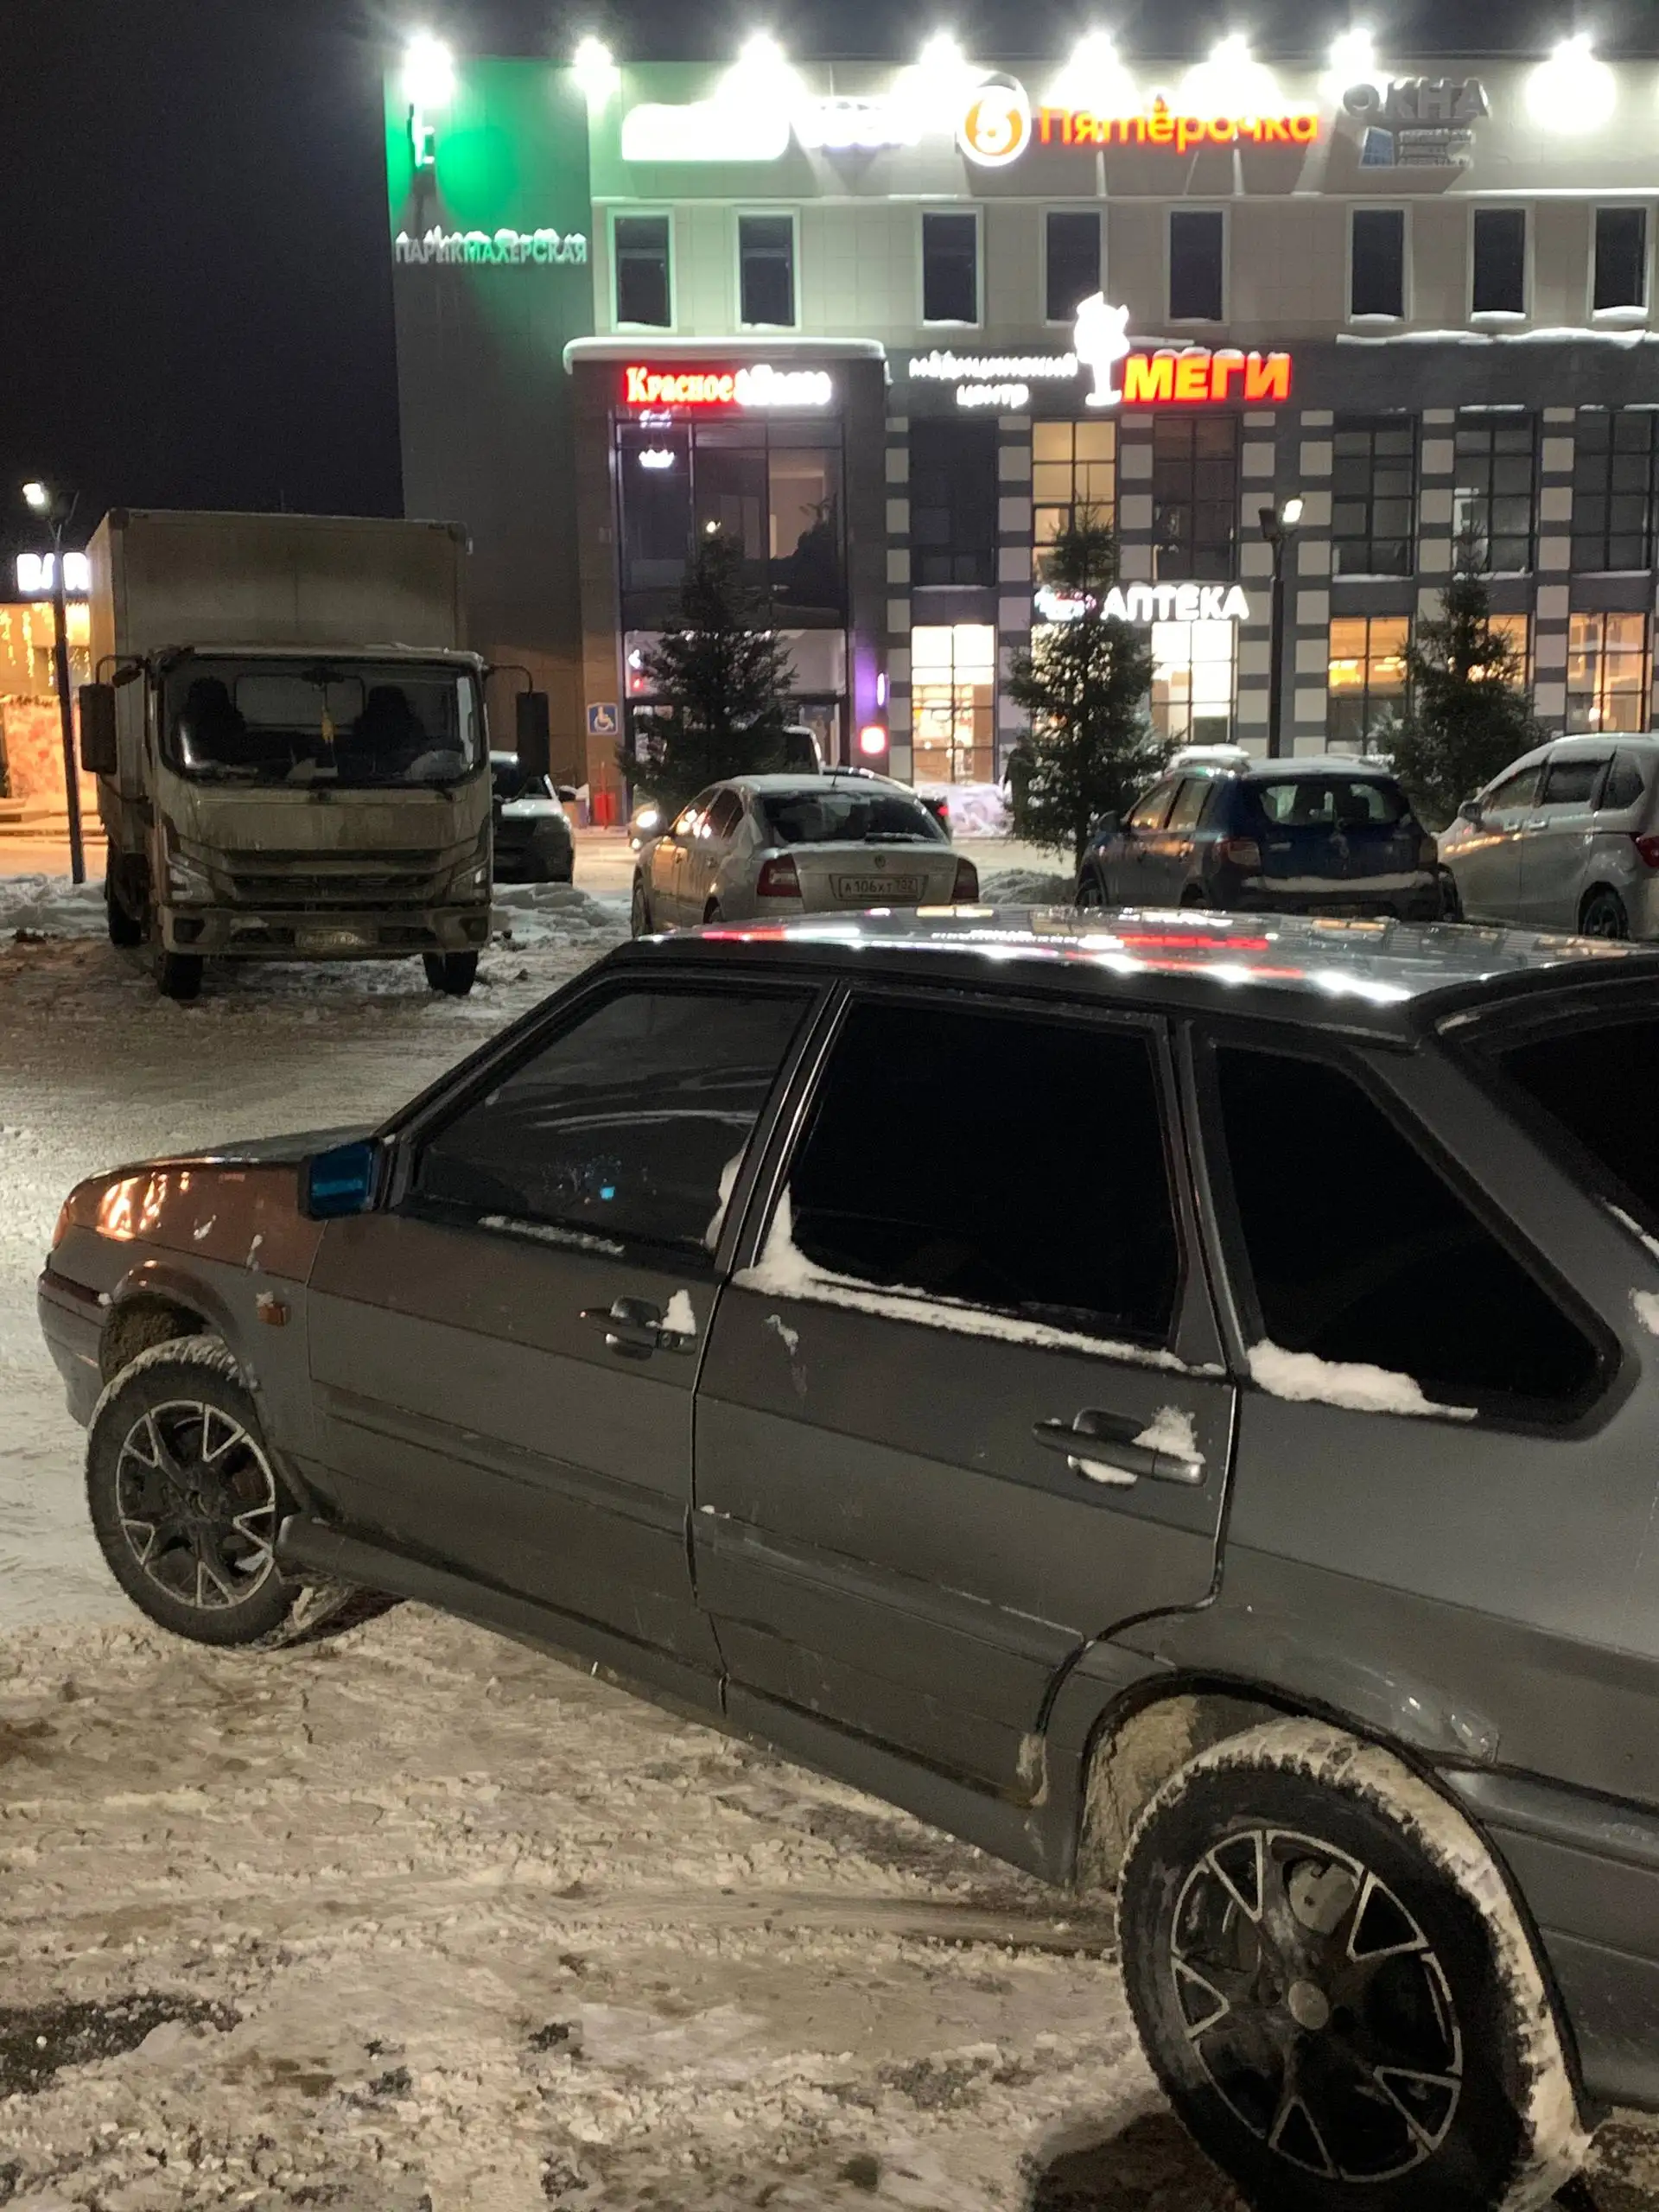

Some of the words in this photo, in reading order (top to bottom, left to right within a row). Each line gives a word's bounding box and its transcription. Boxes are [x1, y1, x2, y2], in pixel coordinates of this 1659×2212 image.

[1343, 78, 1488, 119] ОКНА
[1039, 97, 1319, 153] Пятёрочка
[396, 235, 587, 264] ПАРИКМАХЕРСКАЯ
[1122, 353, 1292, 402] МЕГИ
[1099, 584, 1249, 620] АПТЕКА
